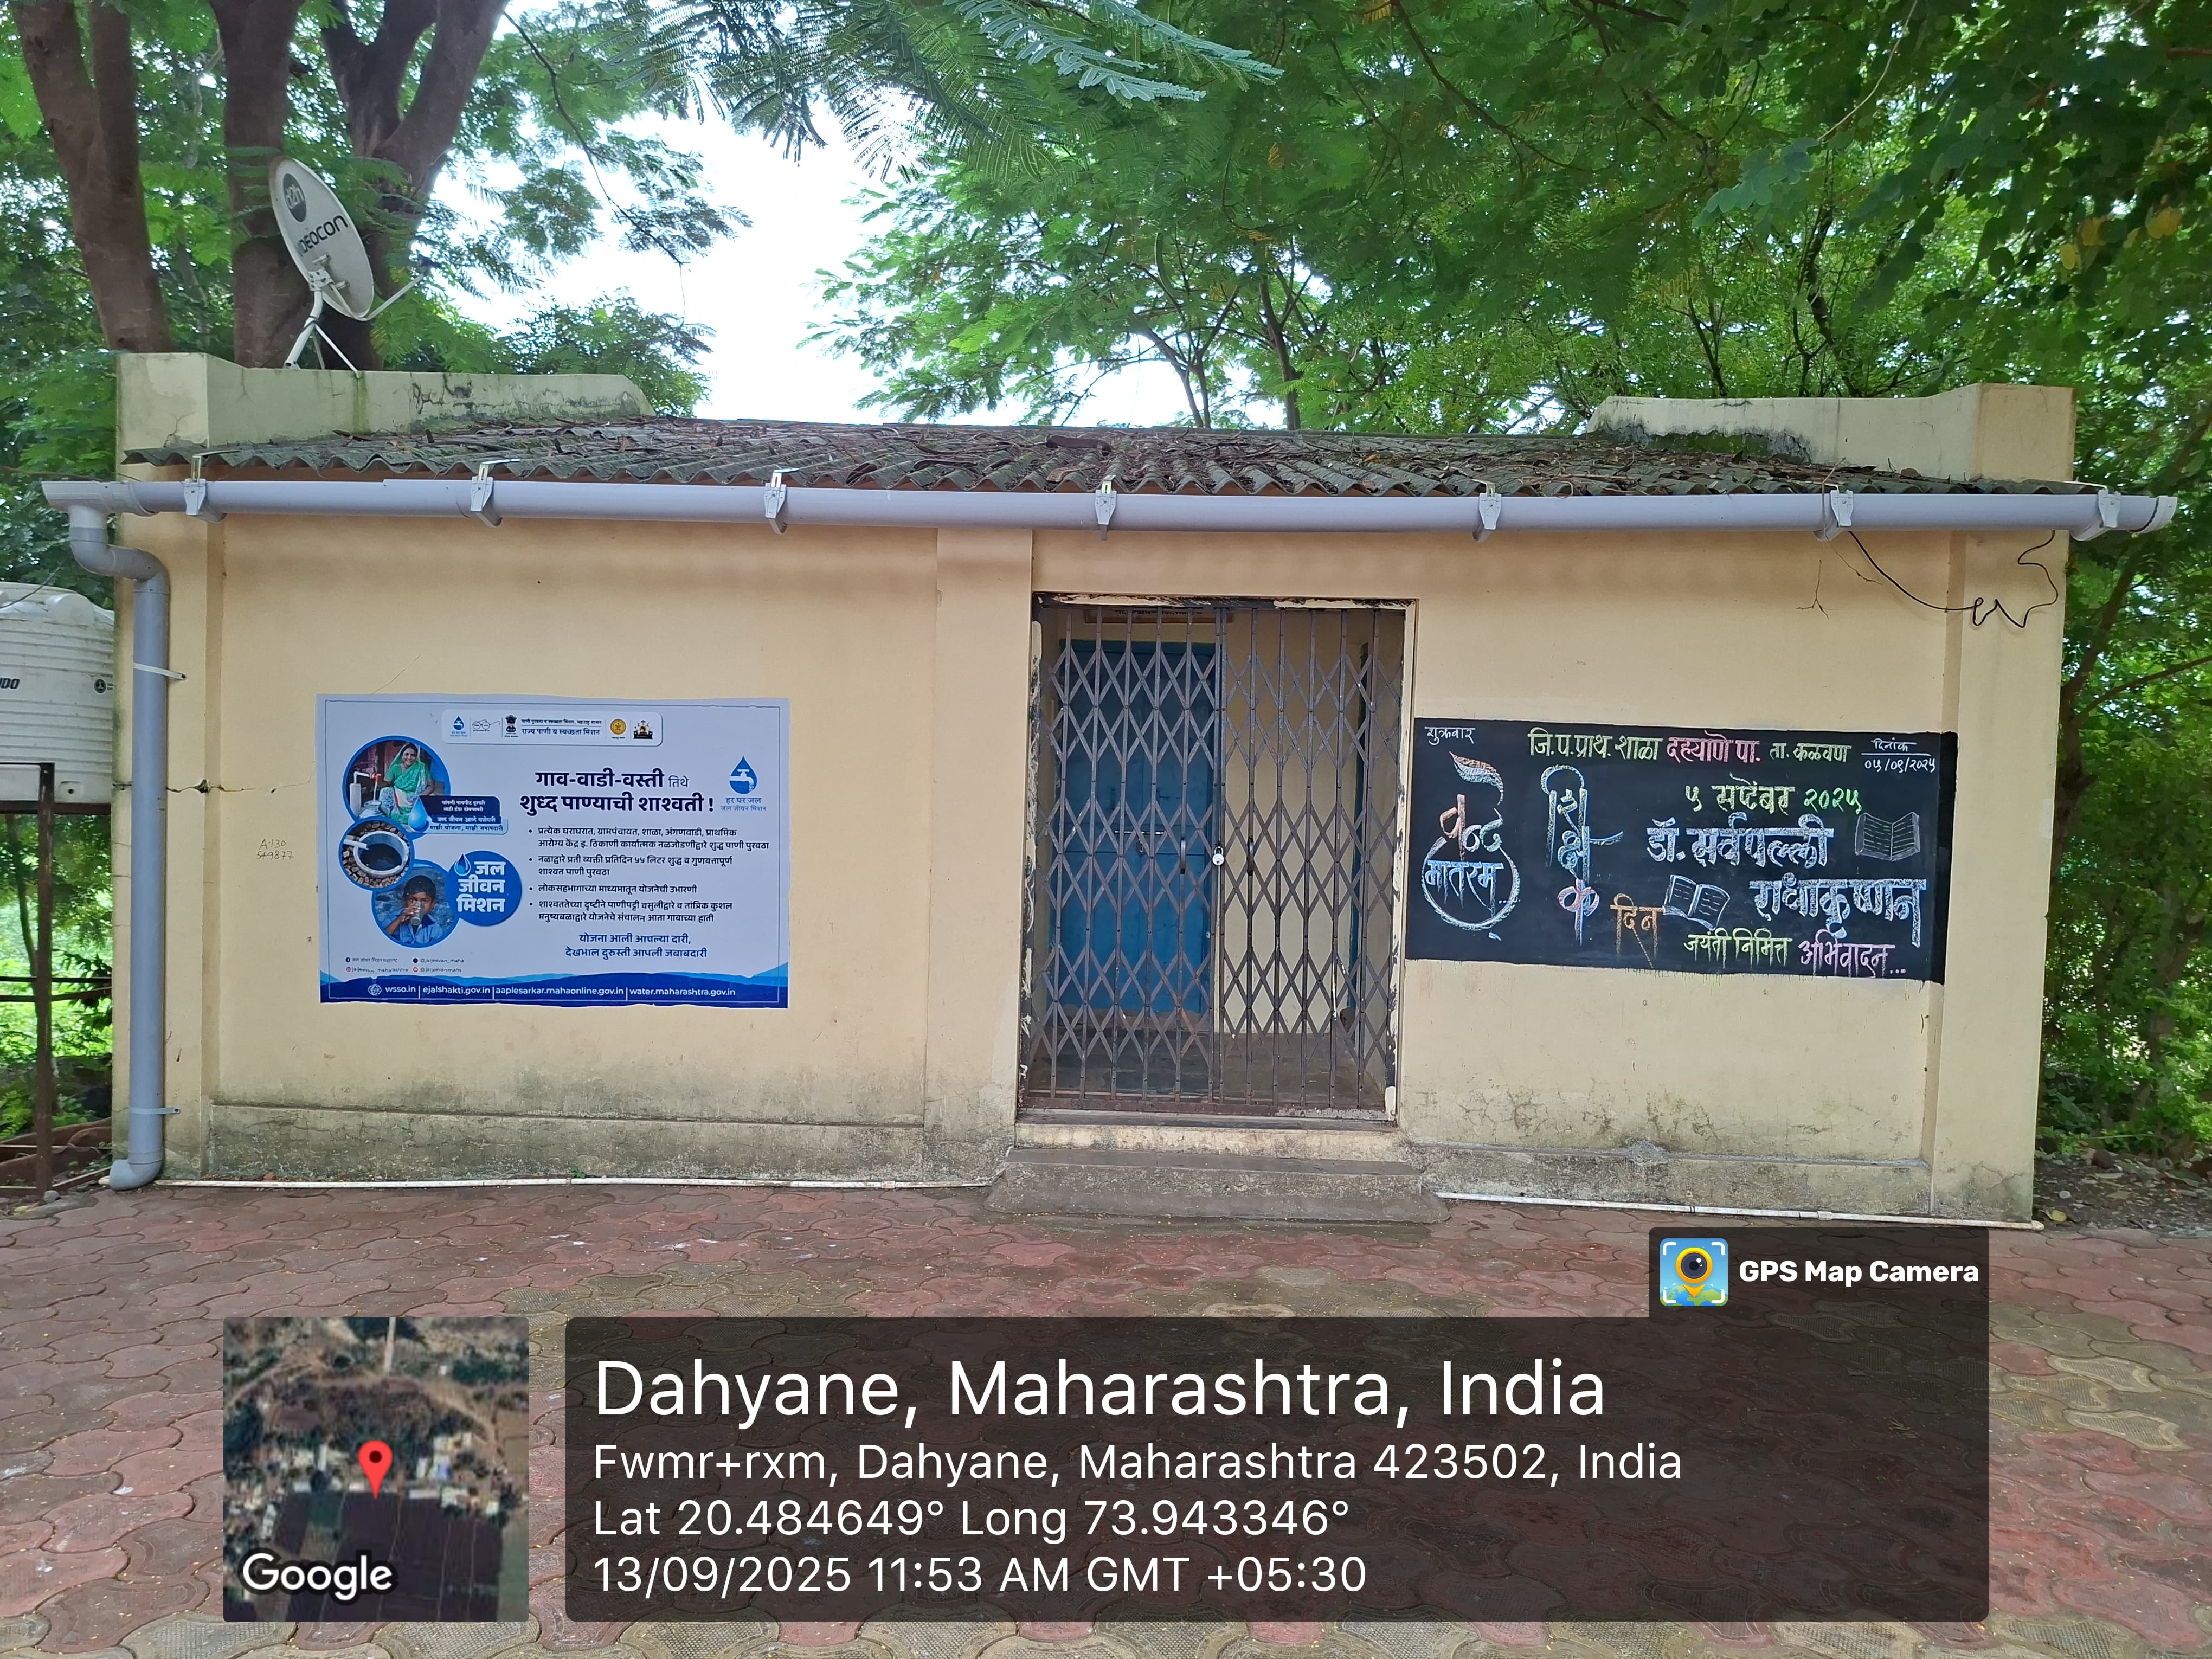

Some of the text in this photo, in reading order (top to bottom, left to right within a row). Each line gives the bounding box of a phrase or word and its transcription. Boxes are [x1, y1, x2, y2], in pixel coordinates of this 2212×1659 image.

[1424, 726, 1476, 745] शुक्रवार
[1615, 735, 1663, 761] शाळा
[1770, 742, 1790, 760] ता.
[1792, 742, 1852, 763] कळवण
[1870, 737, 1917, 752] दिनांक
[535, 768, 689, 788] गाव-वाडी-वस्ती तिथे
[1685, 772, 1863, 815] ५ सप्टेंबर २०२५
[561, 791, 634, 811] पाण्याची
[639, 792, 704, 812] शाश्वती
[538, 826, 737, 837] प्रत्येक घराघरात, ग्रामपंचायत, शाळा, अंगणवाडी, प्राथमिक
[538, 838, 563, 847] आरोग्य
[565, 838, 578, 848] केंद्र
[589, 839, 618, 847] ठिकाणी
[620, 839, 655, 848] कार्यात्मक
[658, 839, 707, 850] नळजोडणीद्वारे
[710, 842, 724, 851] शुद्ध
[725, 840, 743, 848] पाणी
[745, 842, 769, 851] पुरवठा
[538, 854, 565, 864] नळाद्वारे
[567, 854, 580, 863] प्रती
[582, 854, 602, 863] व्यक्ती
[605, 855, 633, 864] प्रतिदिन
[647, 855, 665, 864] लिटर
[667, 857, 681, 866] शुद्ध
[691, 856, 732, 867] गुणवत्तापूर्ण
[474, 861, 506, 875] जल
[565, 867, 584, 876] पाणी
[586, 869, 609, 878] पुरवठा
[458, 874, 505, 893] जीवन
[538, 883, 697, 895] लोकसहभागाच्या माध्यमातून योजनेची उभारणी
[456, 893, 505, 912] मिशन
[538, 899, 582, 908] शाश्वततेच्या
[584, 899, 606, 910] दृष्टीने
[608, 899, 639, 911] पाणीपट्टी
[641, 900, 674, 911] वसुलीद्वारे
[684, 901, 708, 909] तांत्रिक
[711, 902, 732, 911] कुशल
[538, 912, 587, 923] मनुष्यबळाद्वारे
[589, 912, 615, 921] योजनेचे
[617, 912, 645, 922] संचालन
[698, 913, 713, 923] हाती
[1610, 893, 1664, 968] दिन
[579, 932, 691, 944] योजना आली आपल्या दारी,
[565, 946, 708, 960] देखभाल दुरुस्ती आपली जबाबदारी
[1683, 927, 1731, 969] जयंती
[422, 986, 491, 995] ejalshakti.gov.in
[496, 986, 624, 995] aaplesarkar.mahaonline.gov.in
[629, 987, 736, 996] water.maharashtra.gov.in
